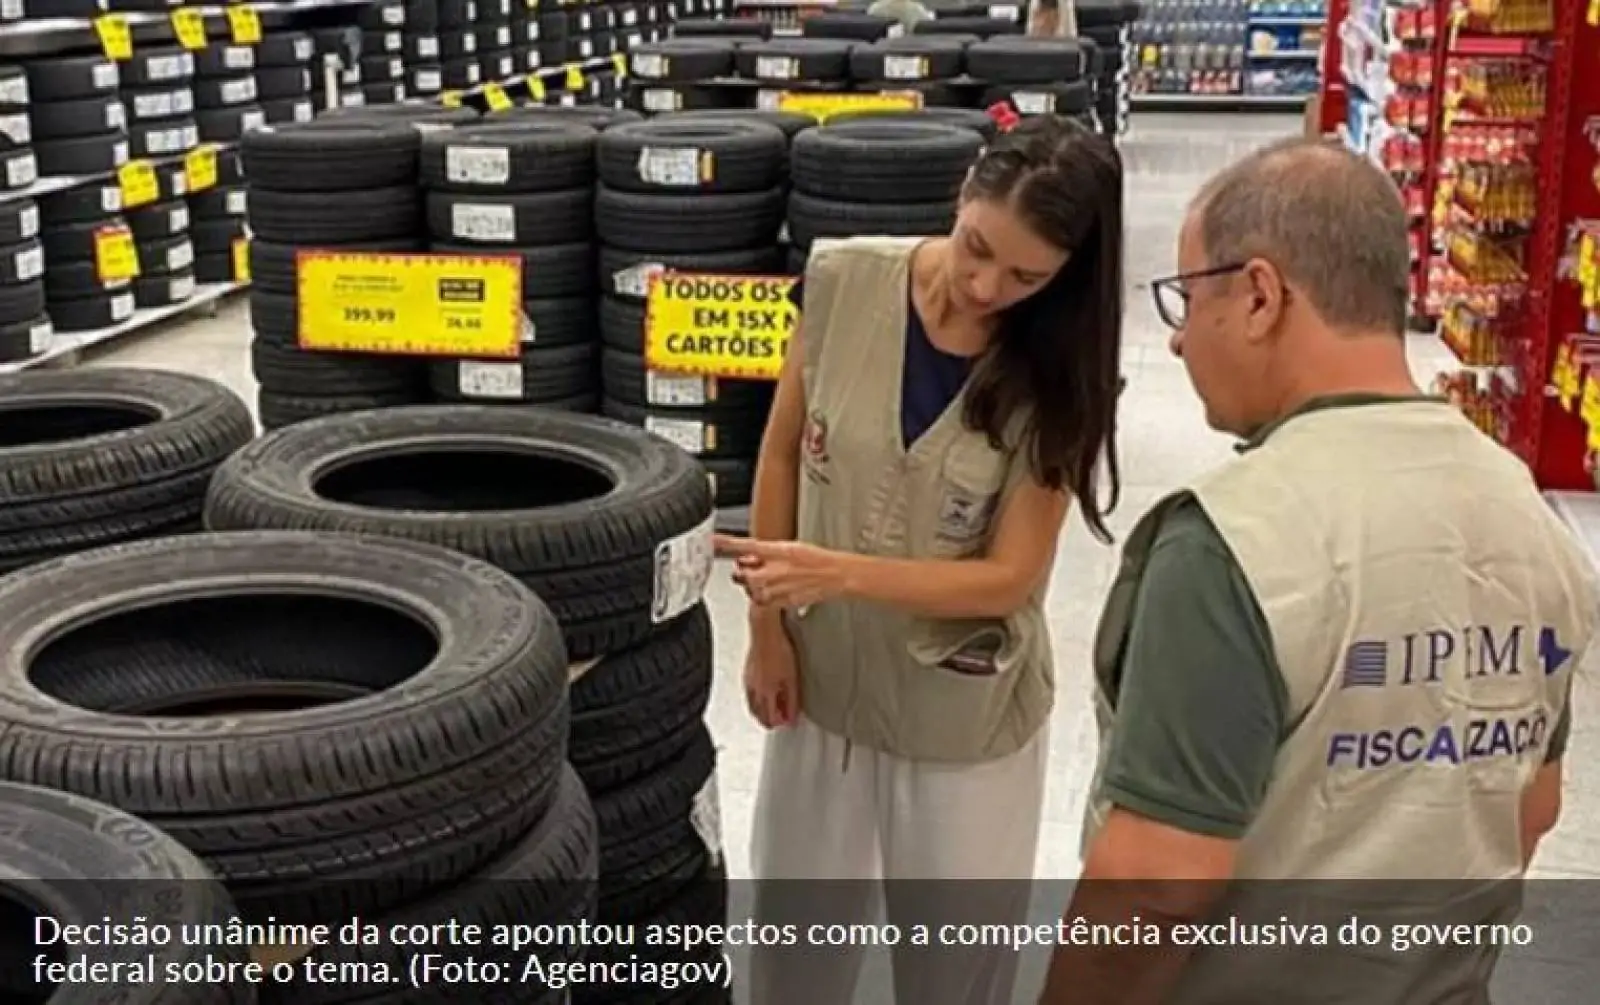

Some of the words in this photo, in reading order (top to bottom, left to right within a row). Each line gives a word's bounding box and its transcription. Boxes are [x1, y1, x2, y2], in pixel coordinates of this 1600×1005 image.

[663, 280, 743, 302] TODOS
[751, 282, 781, 302] OS
[693, 307, 729, 328] EM
[737, 309, 776, 329] 15X
[666, 330, 774, 357] CARTÕES
